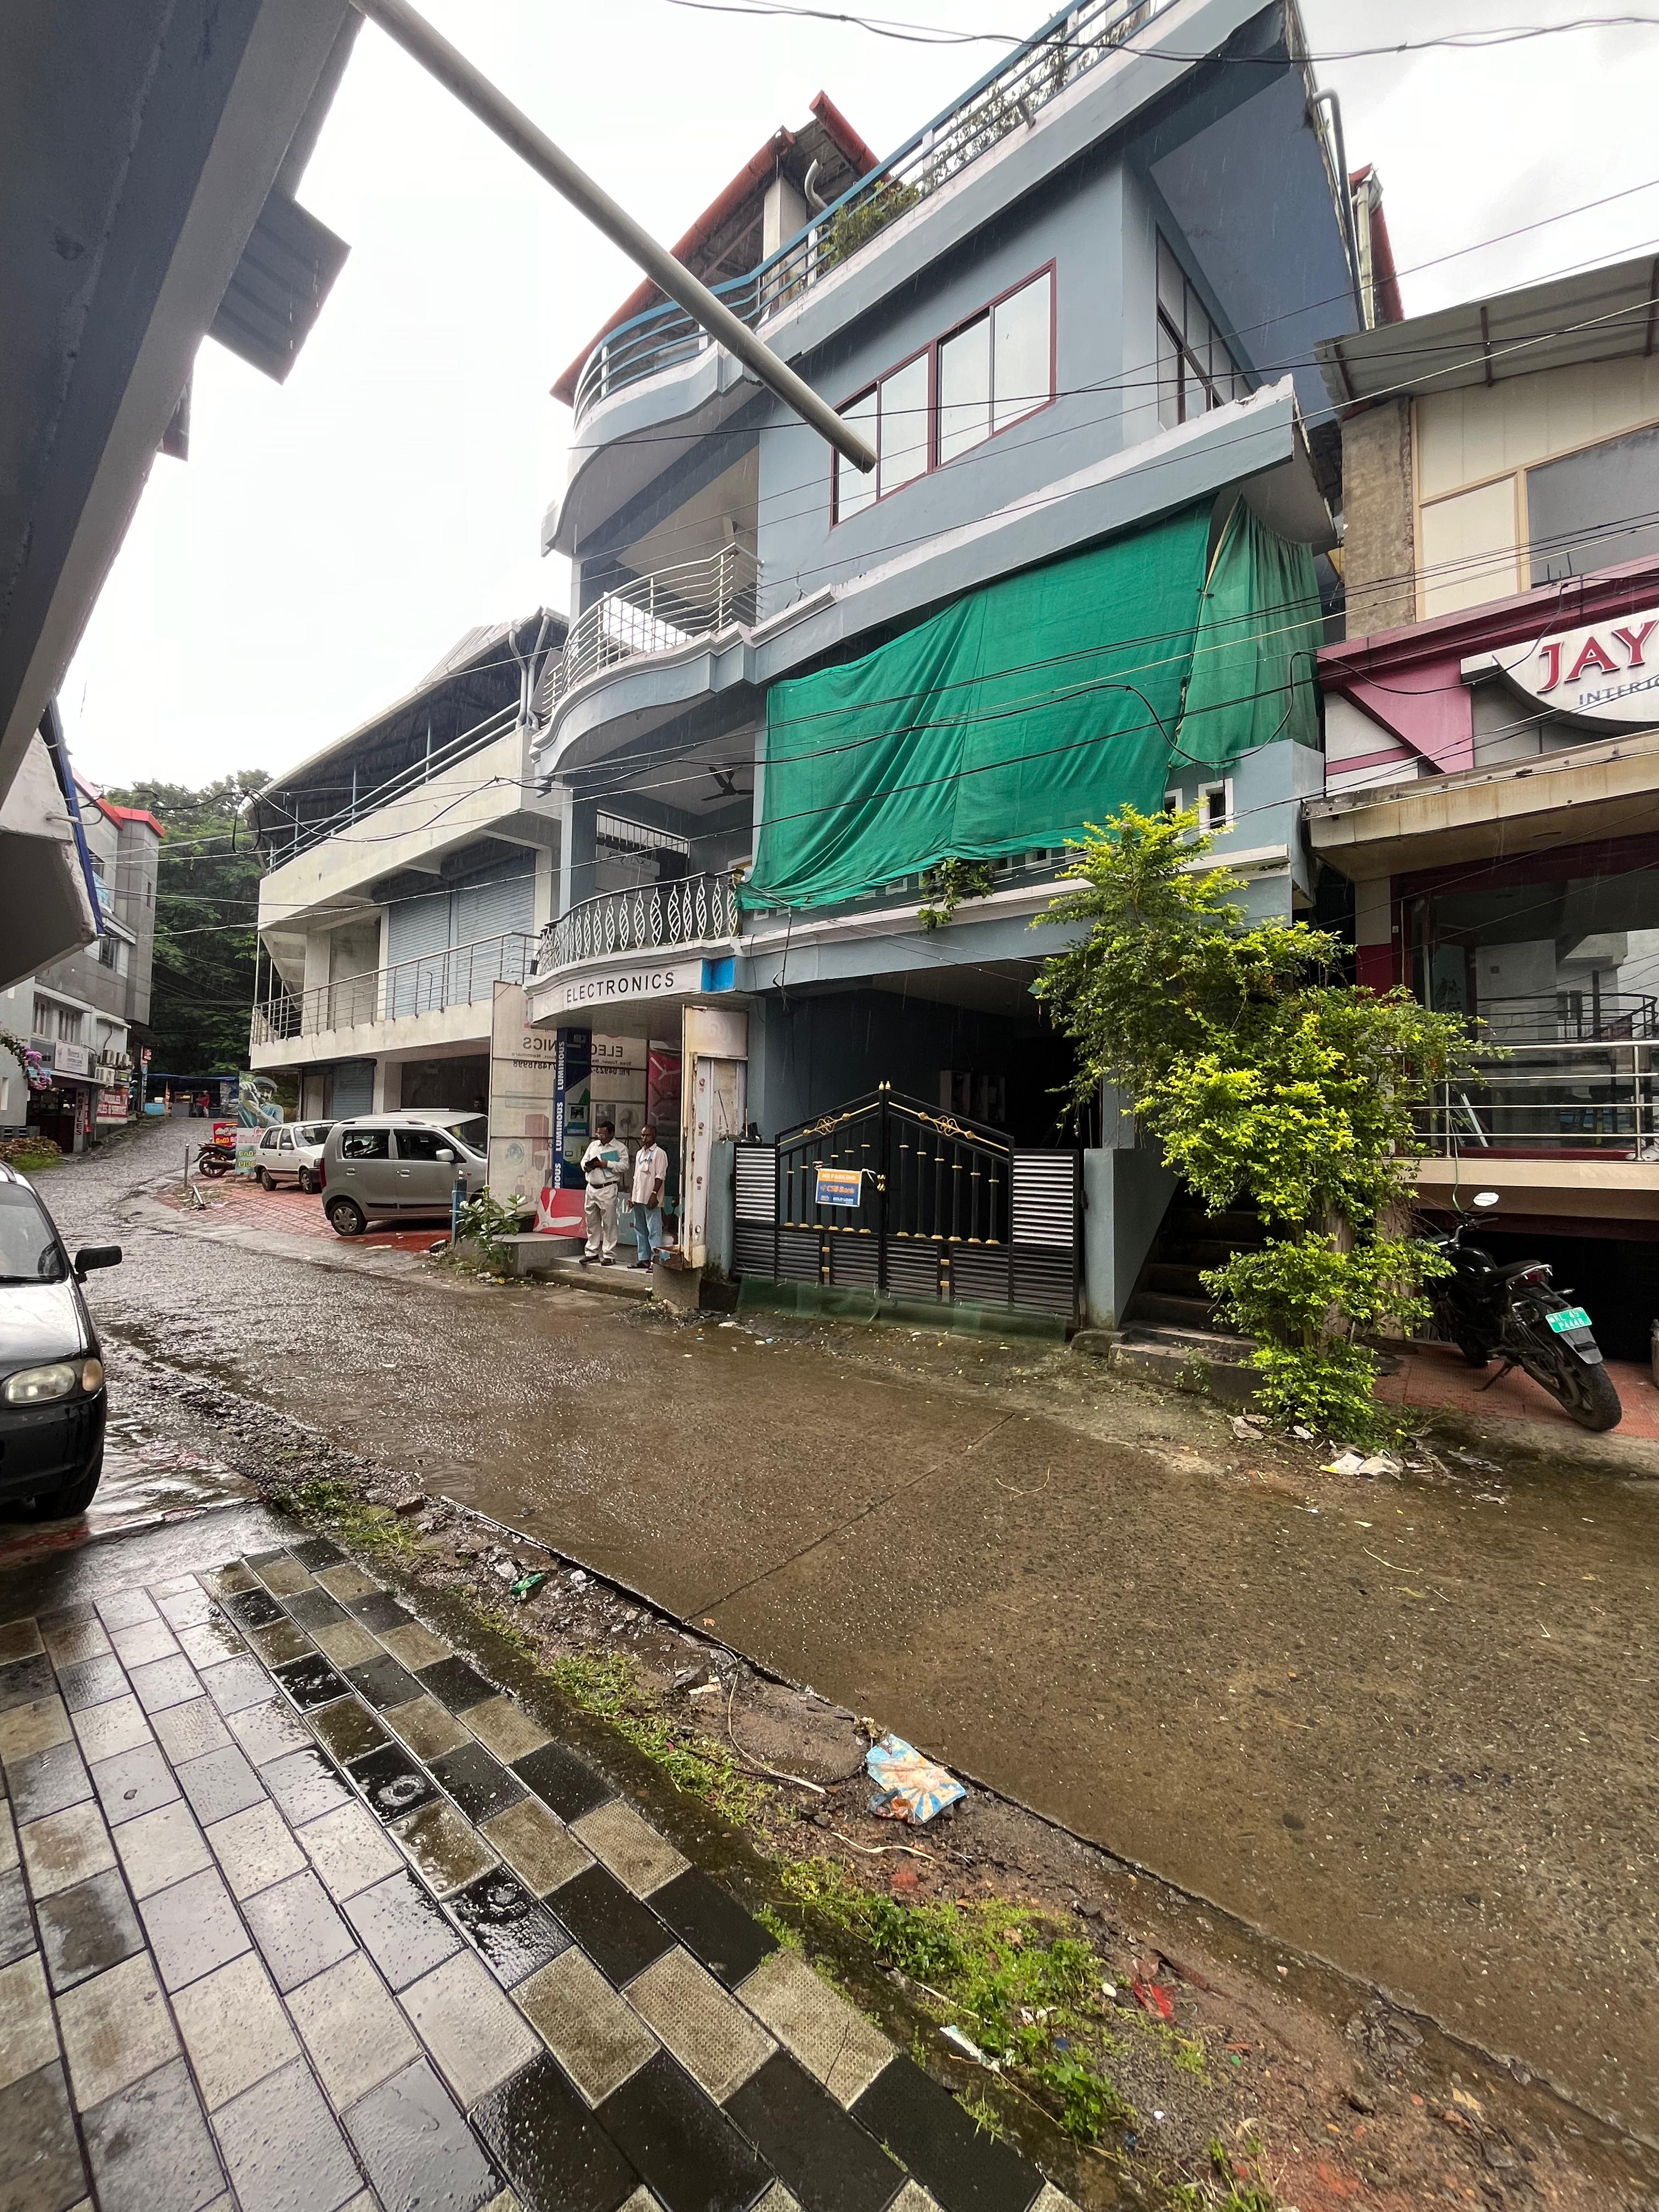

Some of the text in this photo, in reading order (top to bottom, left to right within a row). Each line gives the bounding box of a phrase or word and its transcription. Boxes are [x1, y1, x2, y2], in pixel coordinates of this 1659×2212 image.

[1537, 620, 1659, 693] JAY
[567, 972, 674, 1003] ELECTRONICS
[1553, 1313, 1566, 1322] KL
